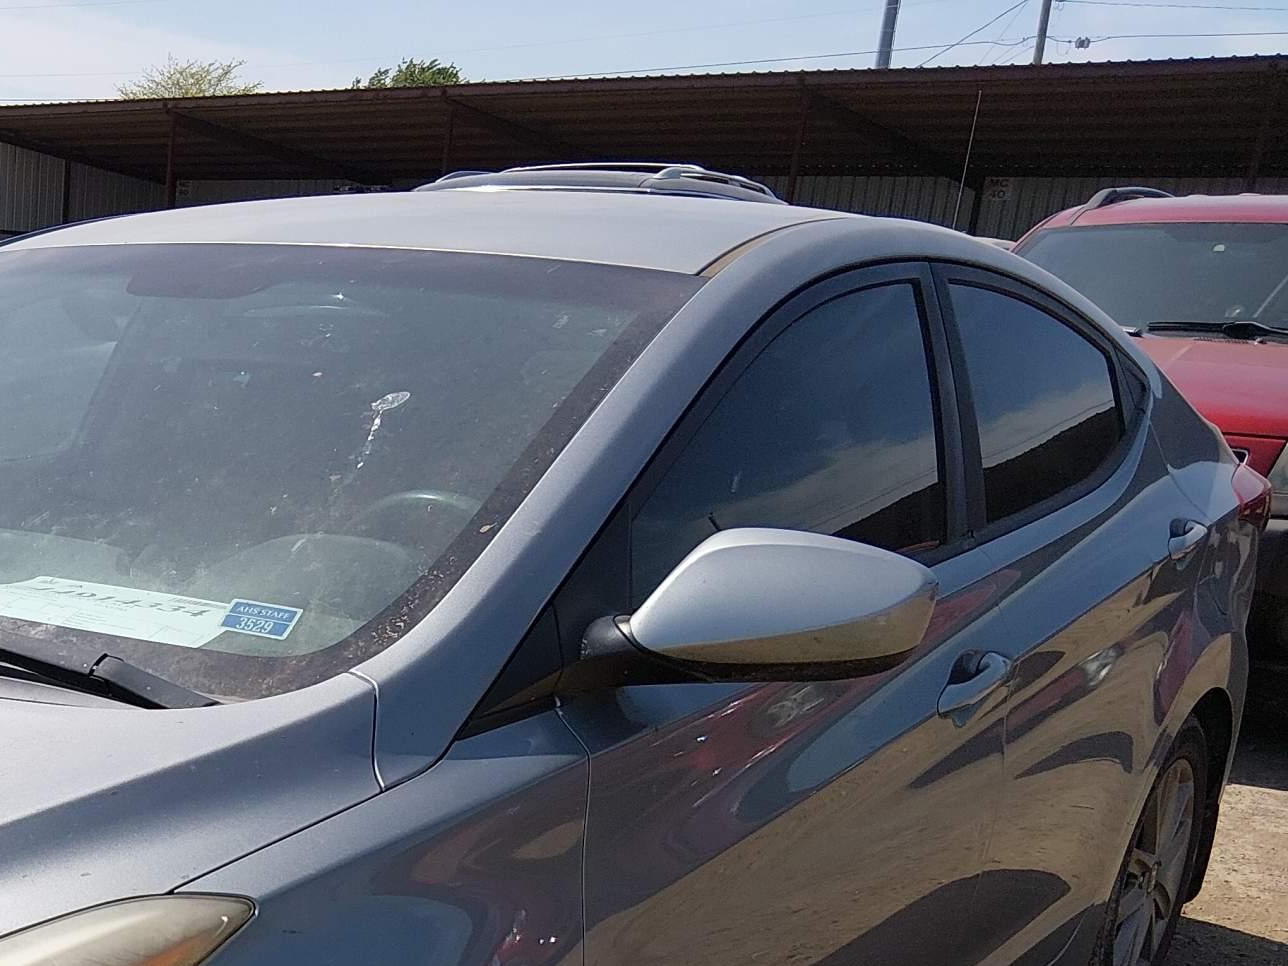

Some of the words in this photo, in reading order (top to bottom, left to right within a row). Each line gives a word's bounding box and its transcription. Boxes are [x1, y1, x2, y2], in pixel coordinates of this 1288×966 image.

[236, 606, 258, 616] AHS
[258, 608, 290, 619] STAFF
[236, 617, 274, 633] 3529
